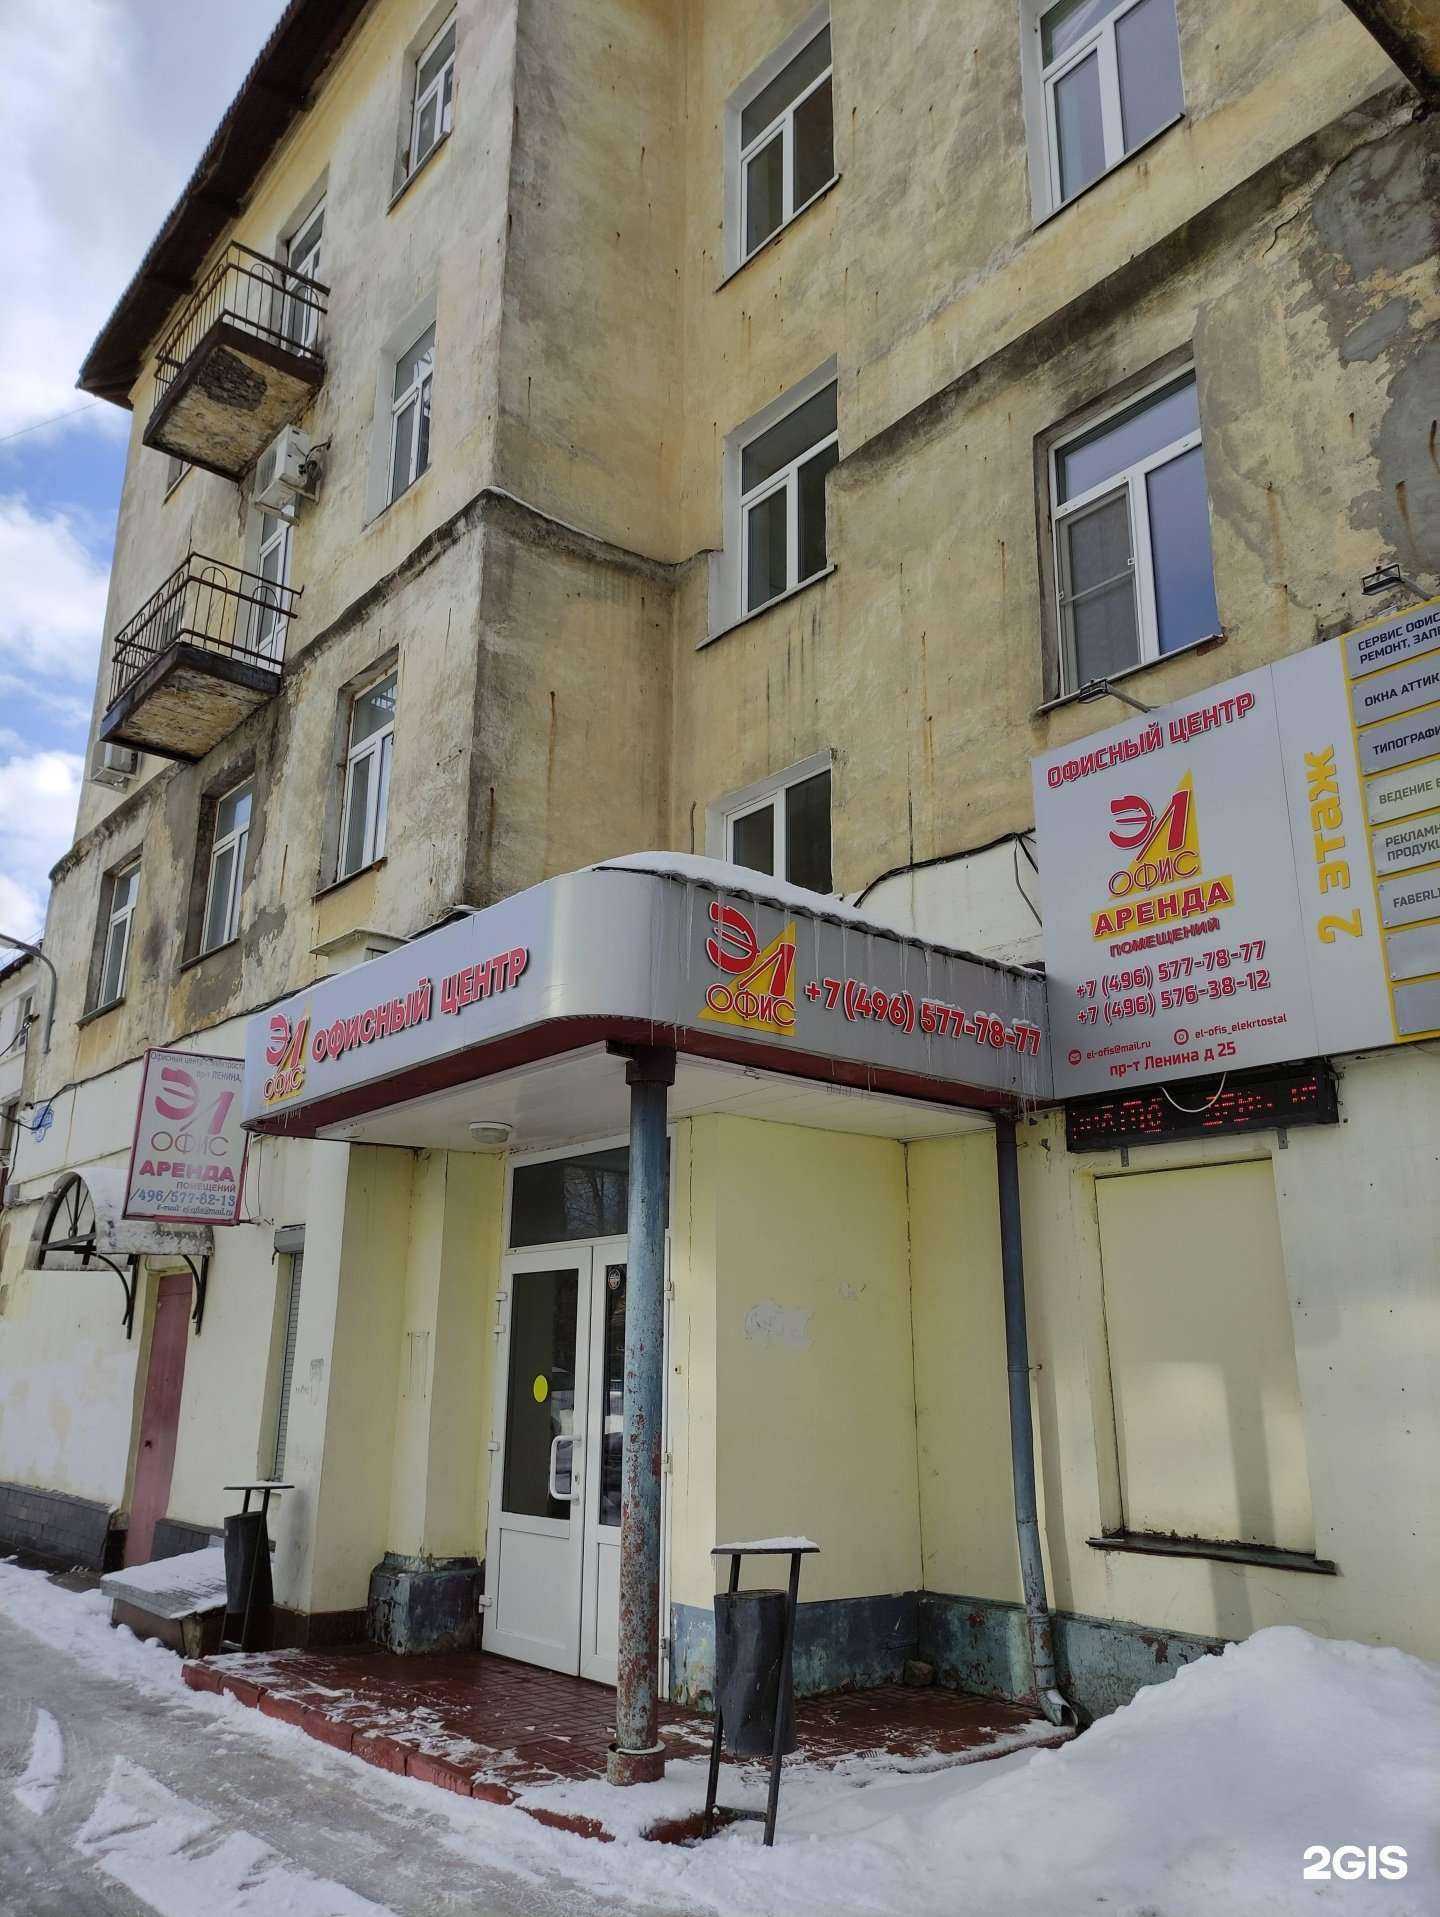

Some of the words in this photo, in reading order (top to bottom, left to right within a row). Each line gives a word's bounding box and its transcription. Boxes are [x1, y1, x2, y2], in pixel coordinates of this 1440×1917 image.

[1358, 627, 1403, 651] СЕРВИС
[1364, 686, 1398, 707] ОКНА
[1401, 672, 1440, 695] АТТИК
[1046, 720, 1164, 788] ОФИСНЫЙ
[1168, 691, 1256, 744] ЦЕНТР
[1379, 780, 1433, 804] ВЕДЕНИЕ
[1108, 789, 1190, 862] ЭЛ
[1108, 850, 1199, 896] ОФИС
[1092, 880, 1231, 937] АРЕНДА
[1317, 907, 1363, 944] 2
[705, 901, 797, 998] ЭЛ
[1109, 917, 1220, 958] ПОМЕЩЕНИЙ
[1076, 978, 1097, 998] +7
[1101, 965, 1153, 998] (496)
[1158, 940, 1266, 983] 577-78-77
[311, 977, 433, 1062] ОФИСНЫЙ
[439, 945, 528, 1015] ЦЕНТР
[706, 983, 797, 1027] ОФИС
[804, 977, 841, 1010] +7
[844, 979, 916, 1034] (496)
[920, 1001, 1042, 1056] 577-78-77
[1077, 1006, 1098, 1025] +7
[1103, 992, 1156, 1026] (496)
[1160, 969, 1271, 1010] 576-38-12
[265, 1013, 309, 1074] ЭЛ
[1086, 1039, 1152, 1060] el-ofis@mail.ru
[1109, 1060, 1140, 1079] пр-т
[1144, 1048, 1200, 1072] Ленина
[1203, 1047, 1215, 1062] д
[1217, 1041, 1236, 1058] 25
[263, 1065, 305, 1100] ОФИС
[139, 1160, 234, 1182] АРЕНДА
